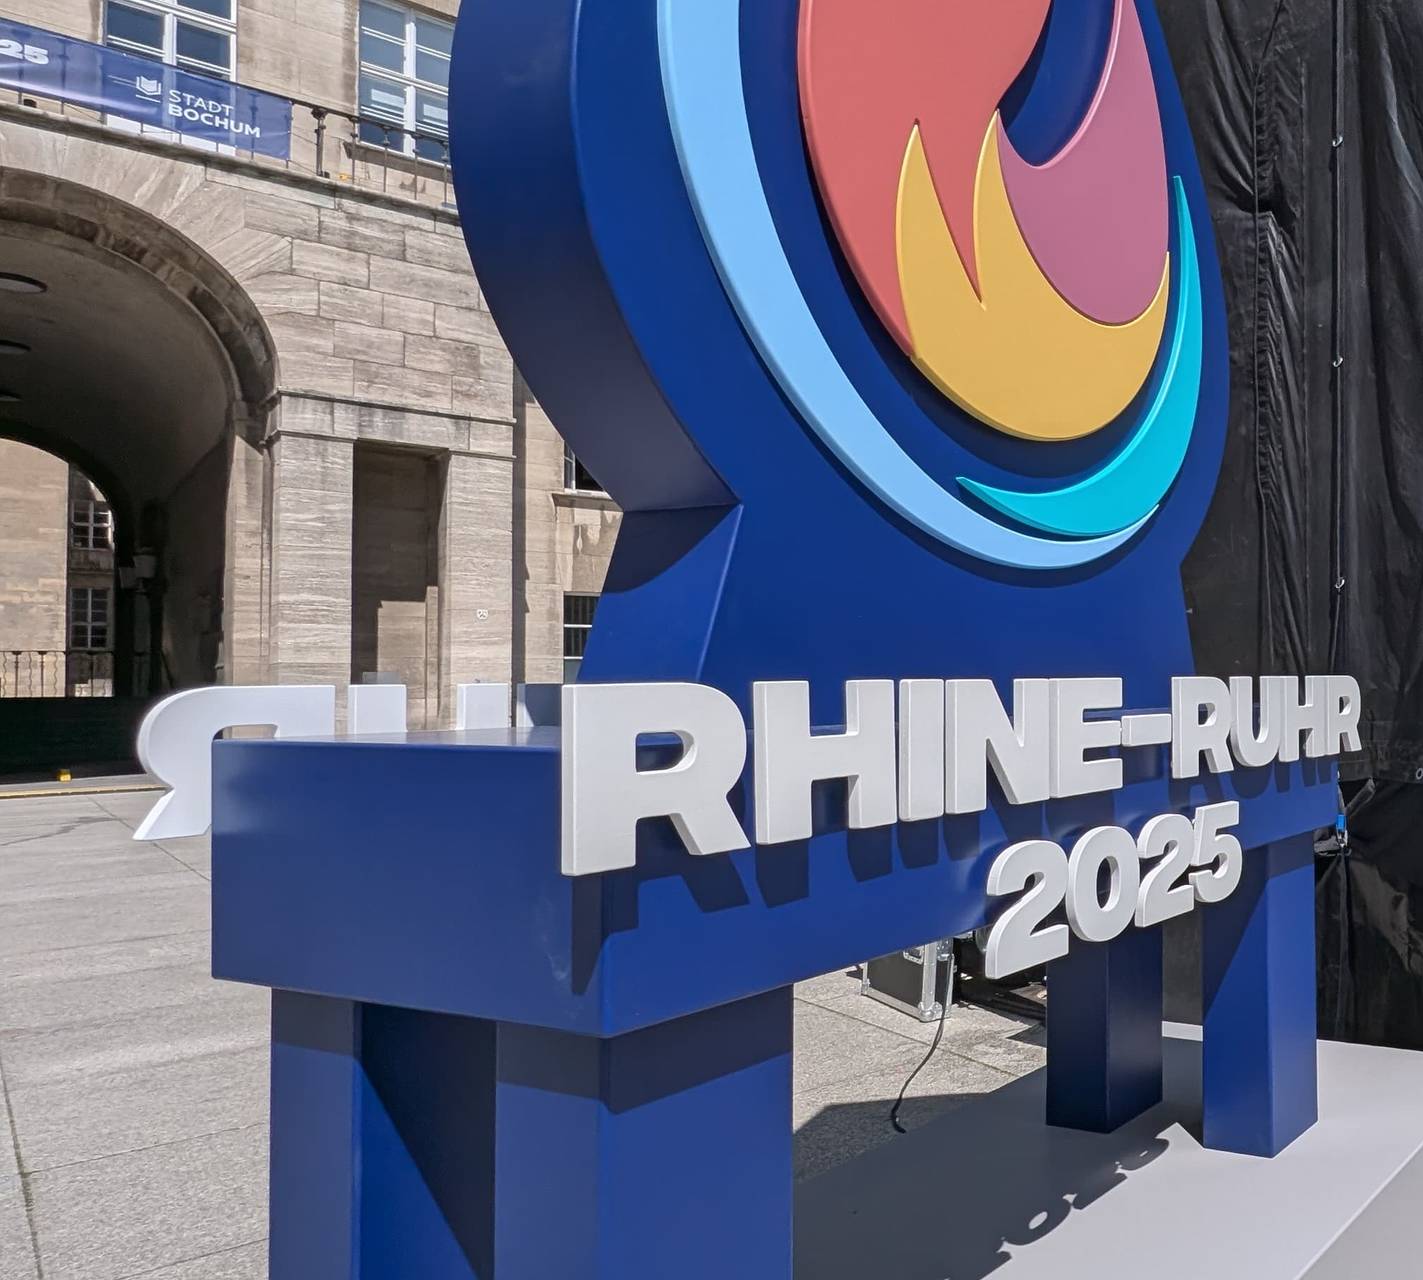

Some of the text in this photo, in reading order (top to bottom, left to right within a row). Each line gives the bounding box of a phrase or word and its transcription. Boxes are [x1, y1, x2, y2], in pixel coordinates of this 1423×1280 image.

[168, 89, 234, 117] STADT
[168, 104, 261, 138] BOCHUM
[561, 674, 1362, 876] RHINE-RUHR
[985, 800, 1243, 980] 2025
